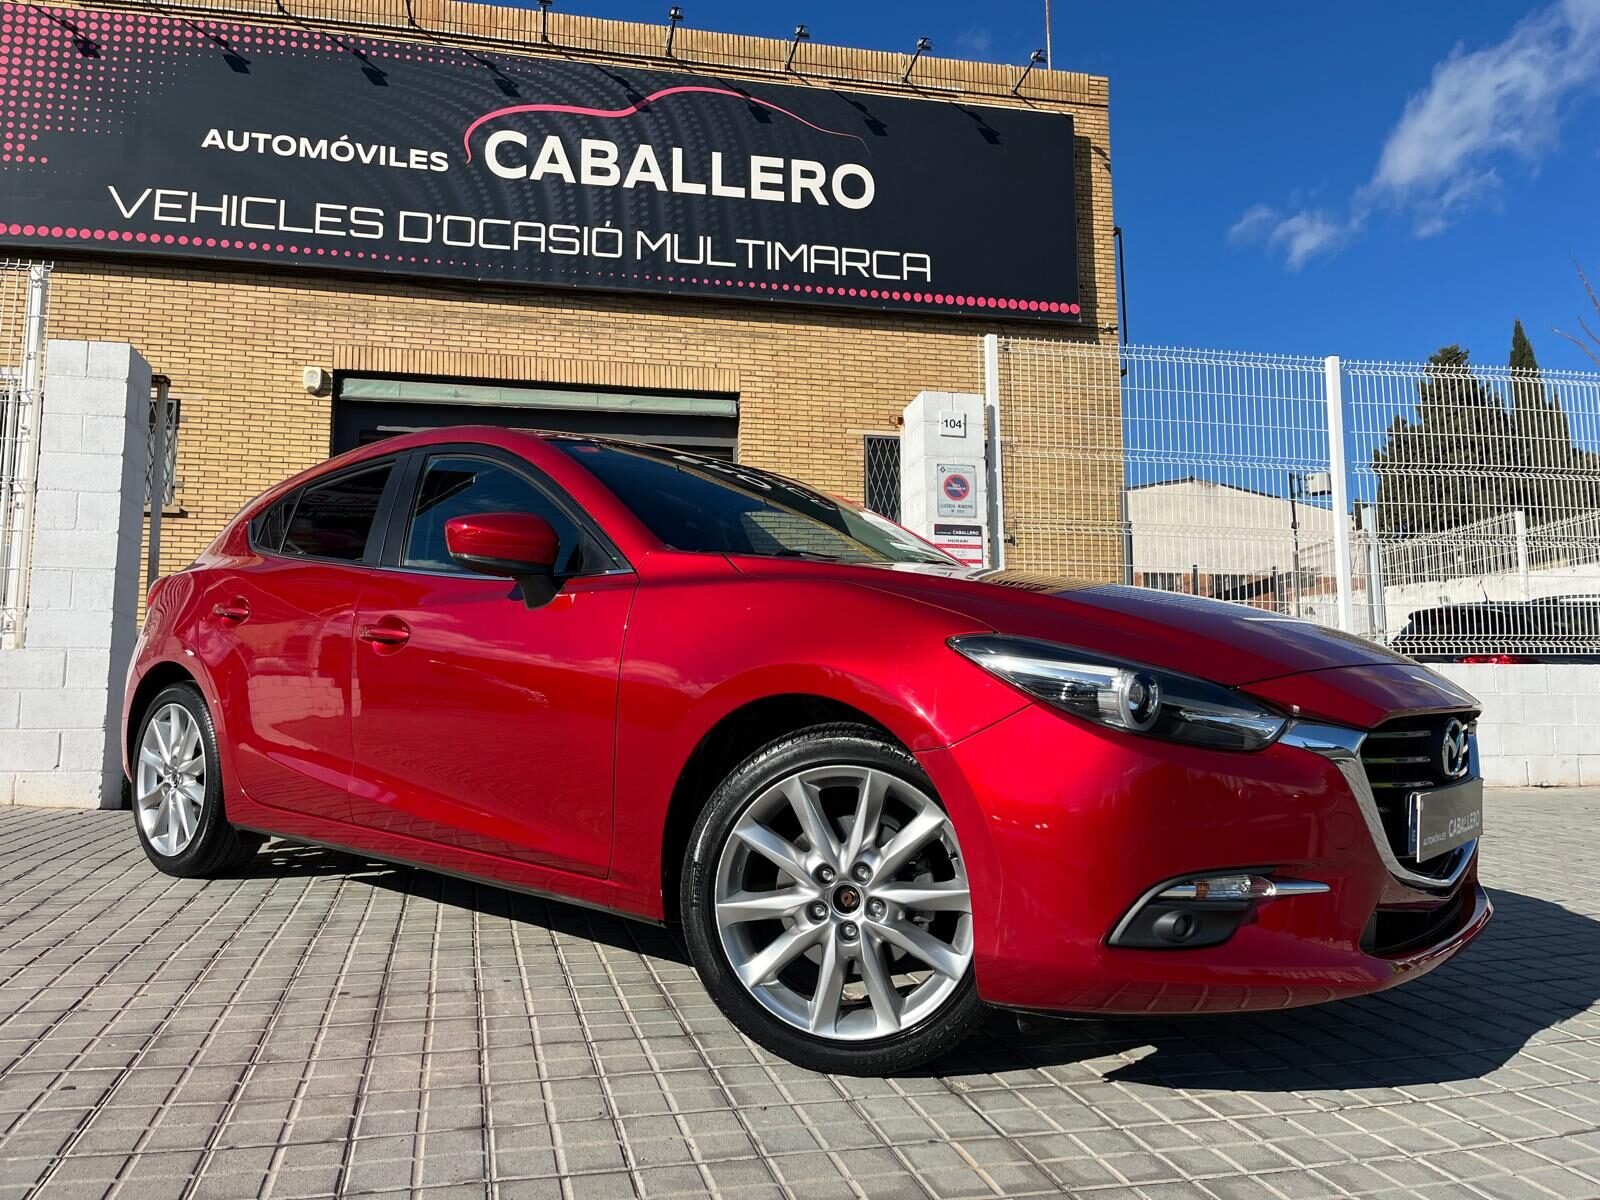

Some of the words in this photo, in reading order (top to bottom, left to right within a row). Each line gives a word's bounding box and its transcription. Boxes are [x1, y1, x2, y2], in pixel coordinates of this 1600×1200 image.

[201, 129, 449, 172] AUTOMÓVILES
[484, 129, 875, 210] CABALLERO
[108, 185, 385, 240] VEHICLES
[398, 210, 623, 259] D'OCASIÓ
[636, 230, 932, 283] MULTIMARCA
[943, 418, 963, 429] 104
[1448, 809, 1480, 838] CABALLERO
